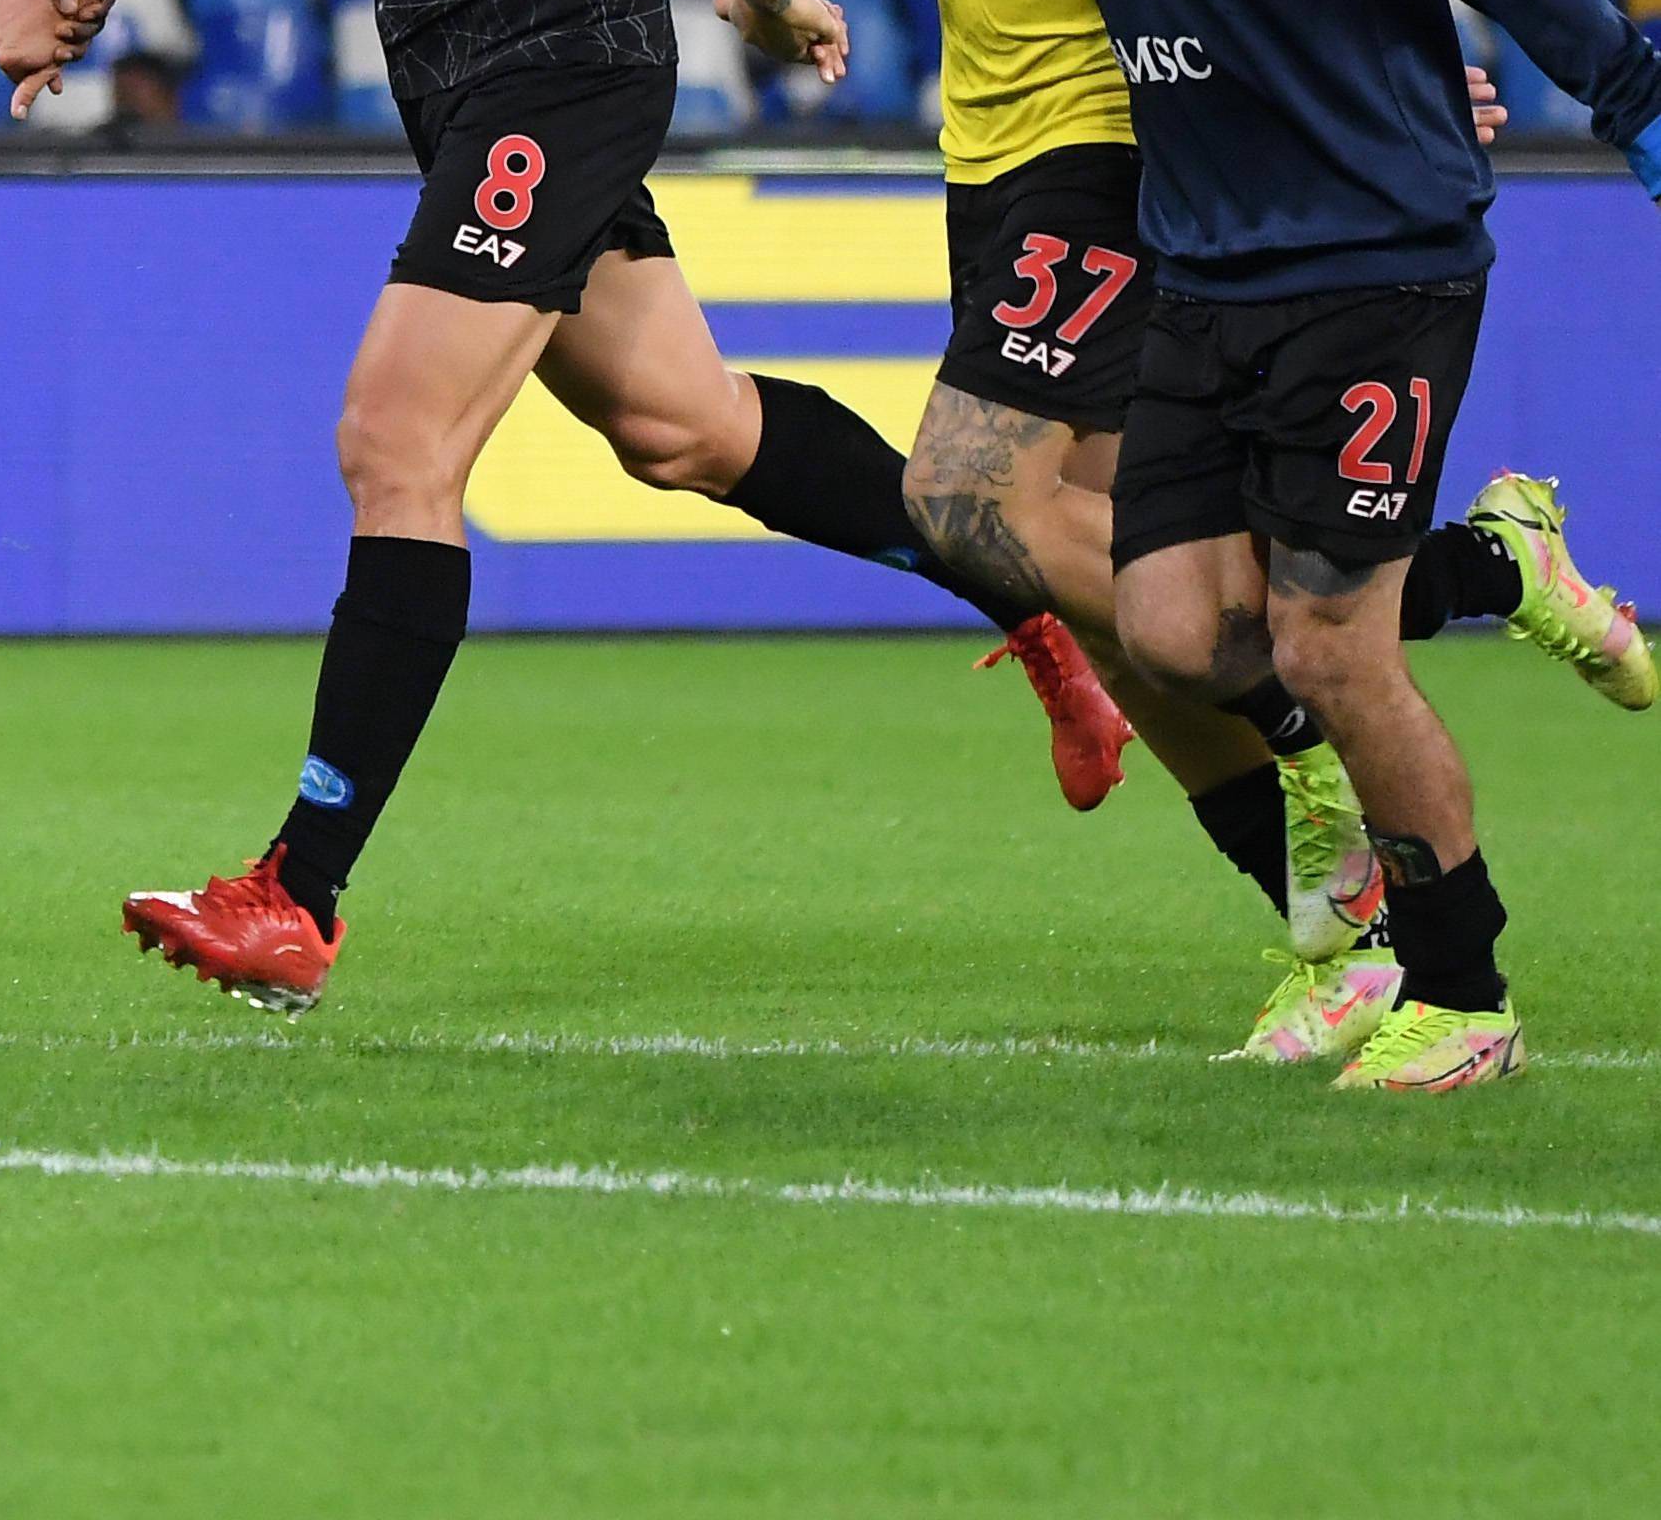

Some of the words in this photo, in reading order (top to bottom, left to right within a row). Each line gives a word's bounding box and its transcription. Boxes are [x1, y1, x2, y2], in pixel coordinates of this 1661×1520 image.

[1116, 36, 1212, 84] MSC
[474, 134, 546, 231] 8
[452, 224, 527, 269] EA7
[991, 233, 1138, 345] 37
[1001, 331, 1077, 378] EA7
[1338, 377, 1431, 485] 21
[1346, 489, 1408, 521] EA7
